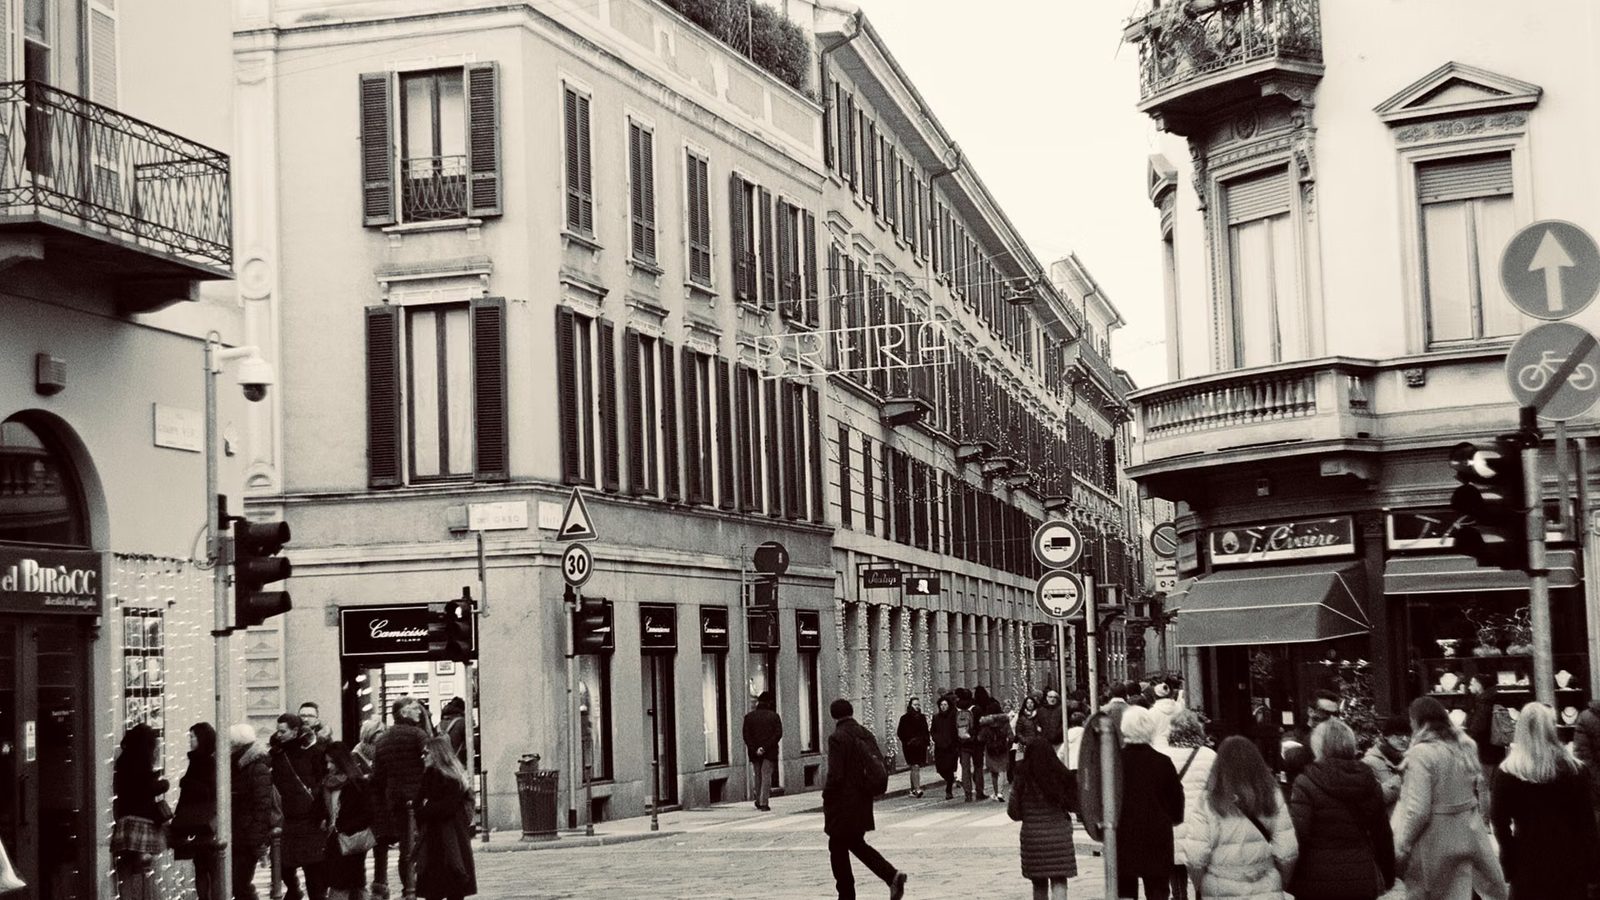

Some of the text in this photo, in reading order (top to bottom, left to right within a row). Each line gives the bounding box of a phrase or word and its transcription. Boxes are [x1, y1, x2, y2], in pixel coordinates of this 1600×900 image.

[755, 320, 951, 379] BRERA
[568, 554, 586, 575] 30
[2, 566, 18, 592] el
